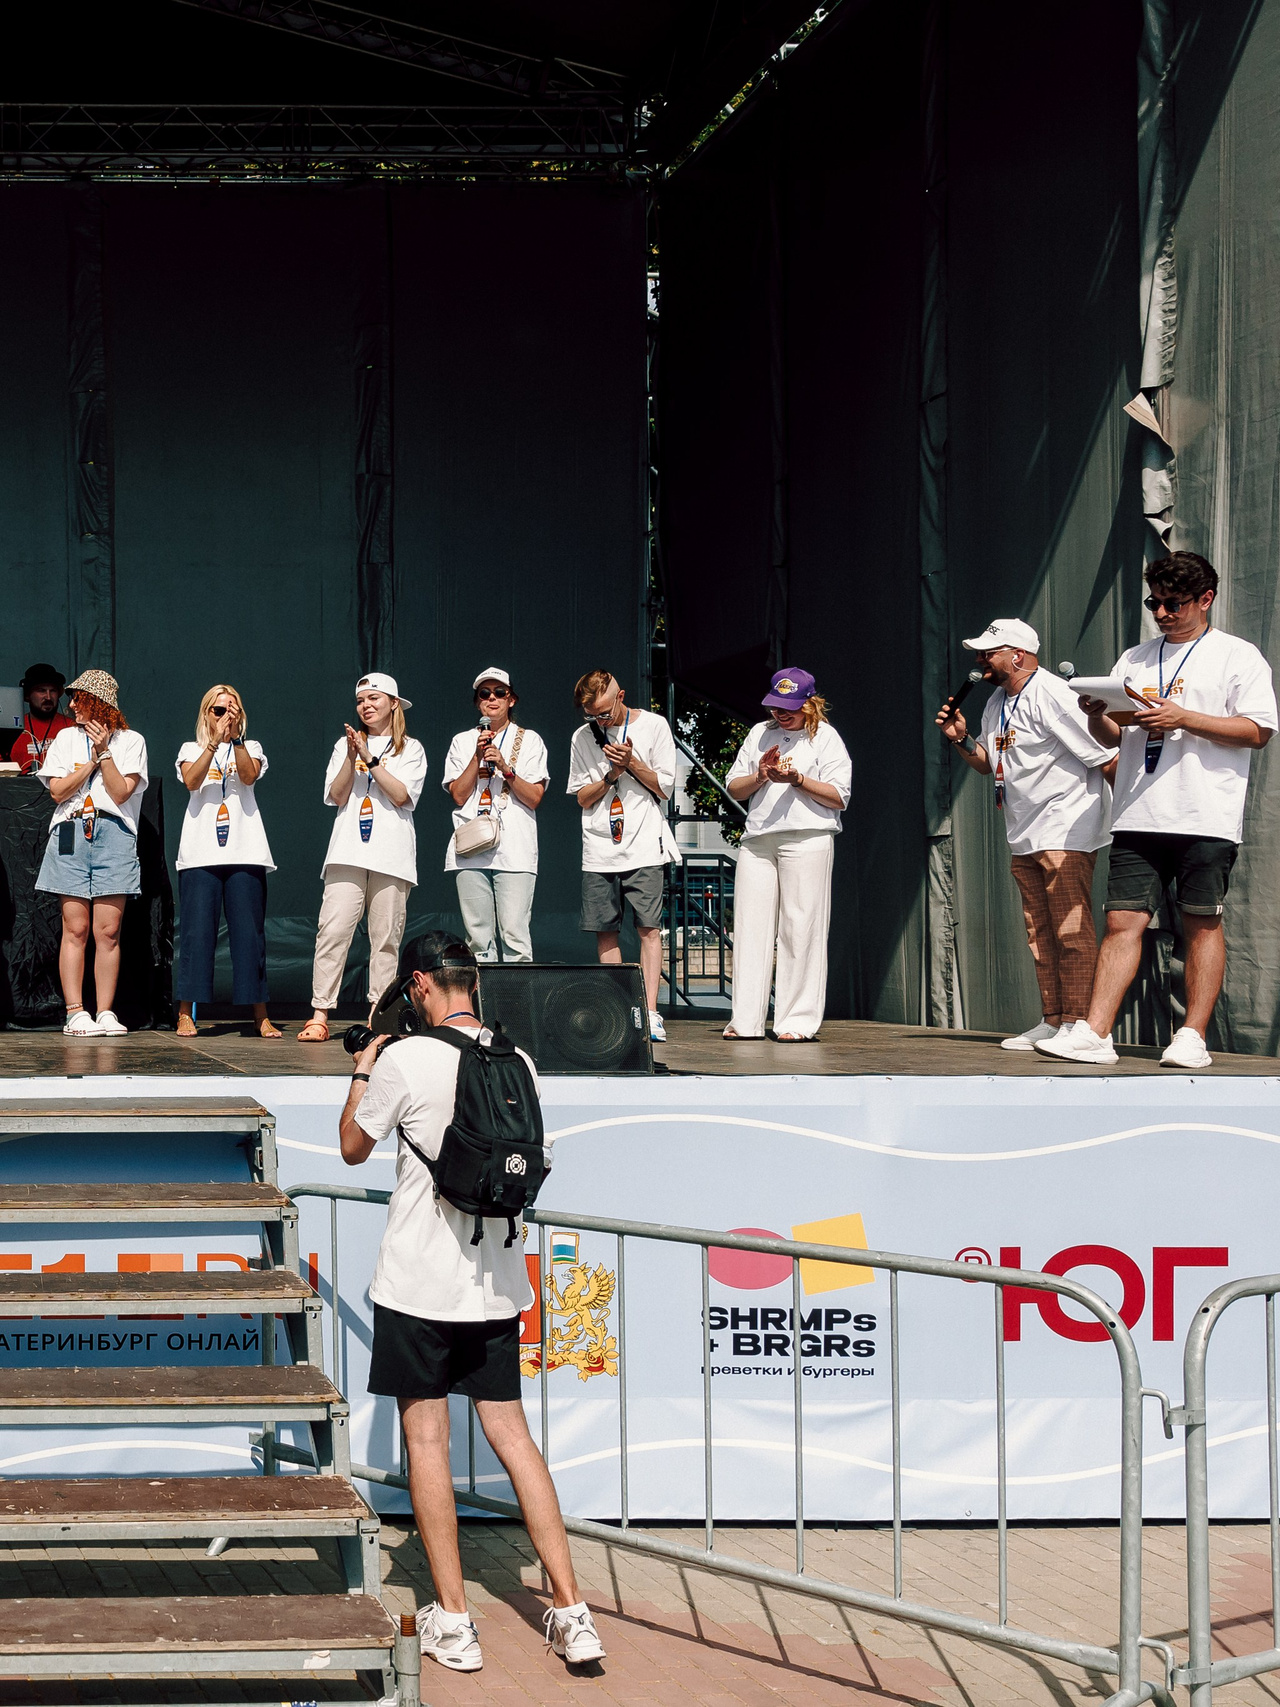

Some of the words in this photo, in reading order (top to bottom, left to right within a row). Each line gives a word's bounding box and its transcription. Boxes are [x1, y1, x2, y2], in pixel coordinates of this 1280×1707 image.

[701, 1306, 877, 1332] SHRMPs
[166, 1328, 278, 1351] ОНЛАЙ
[732, 1333, 876, 1358] BRGRs
[802, 1365, 875, 1379] бургеры
